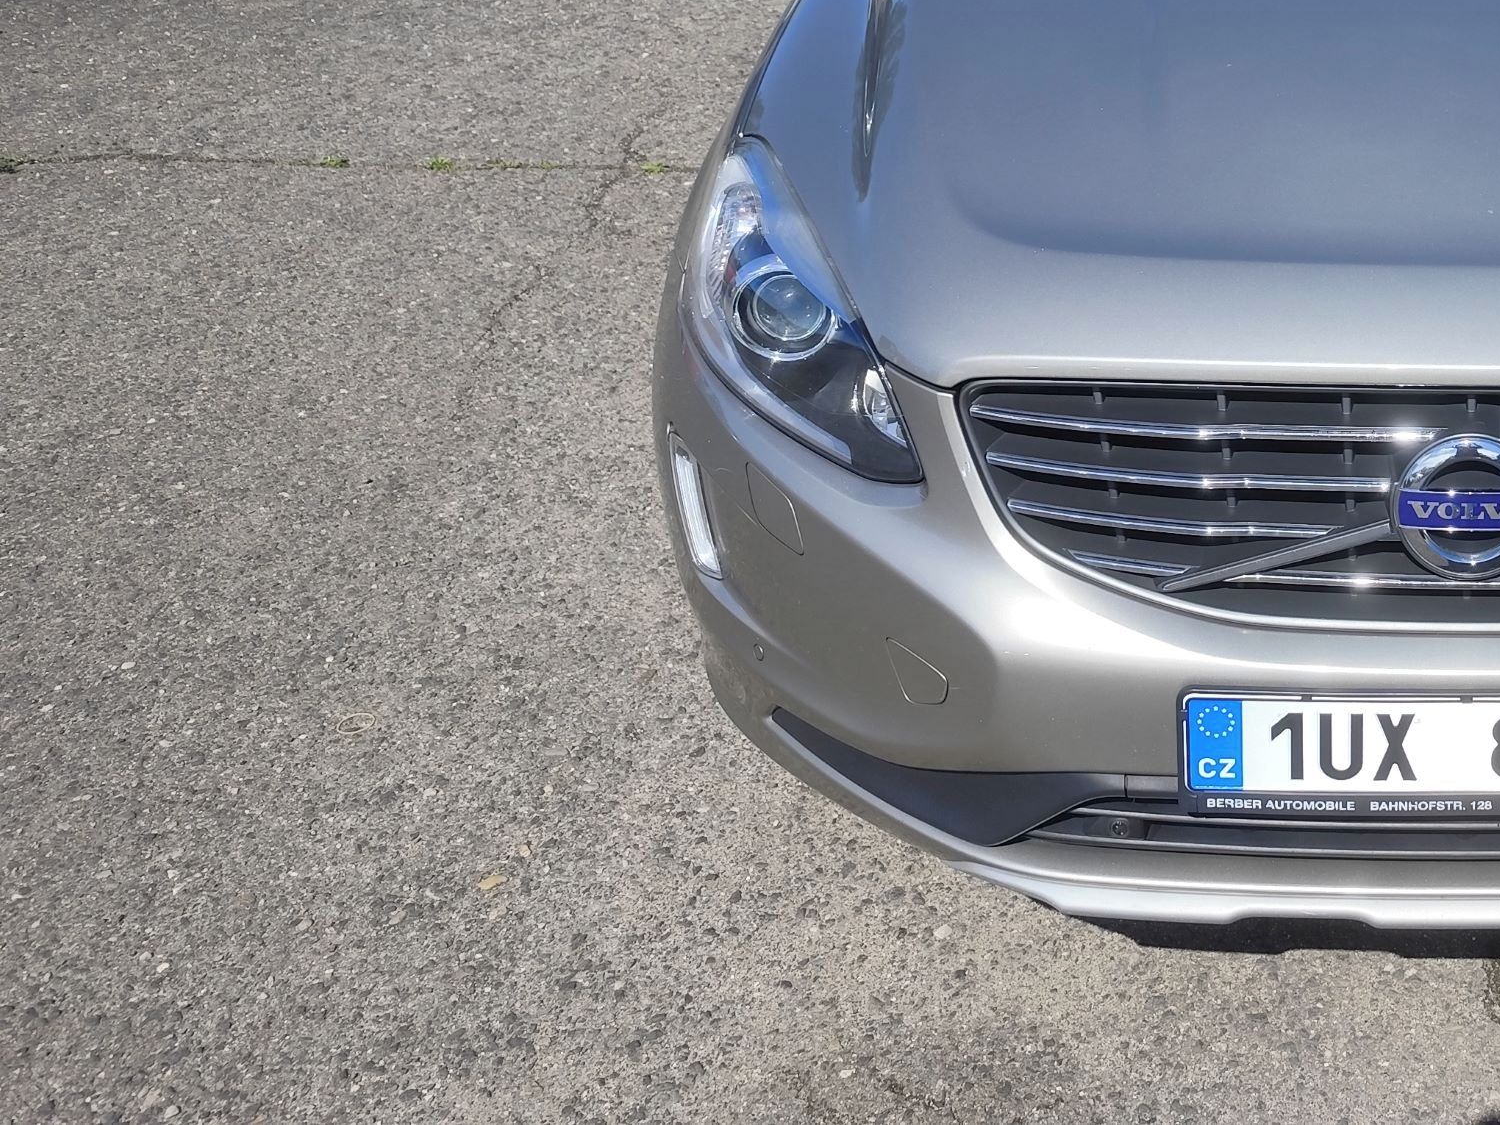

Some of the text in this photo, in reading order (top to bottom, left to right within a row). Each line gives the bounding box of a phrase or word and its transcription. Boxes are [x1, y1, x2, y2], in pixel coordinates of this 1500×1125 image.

[1270, 712, 1418, 781] 1UX
[1198, 757, 1236, 779] CZ
[1206, 798, 1262, 810] BERBER
[1265, 800, 1356, 811] AUTOMOBILE
[1370, 801, 1466, 812] BAHNHOFSTR.
[1470, 800, 1493, 811] 128
